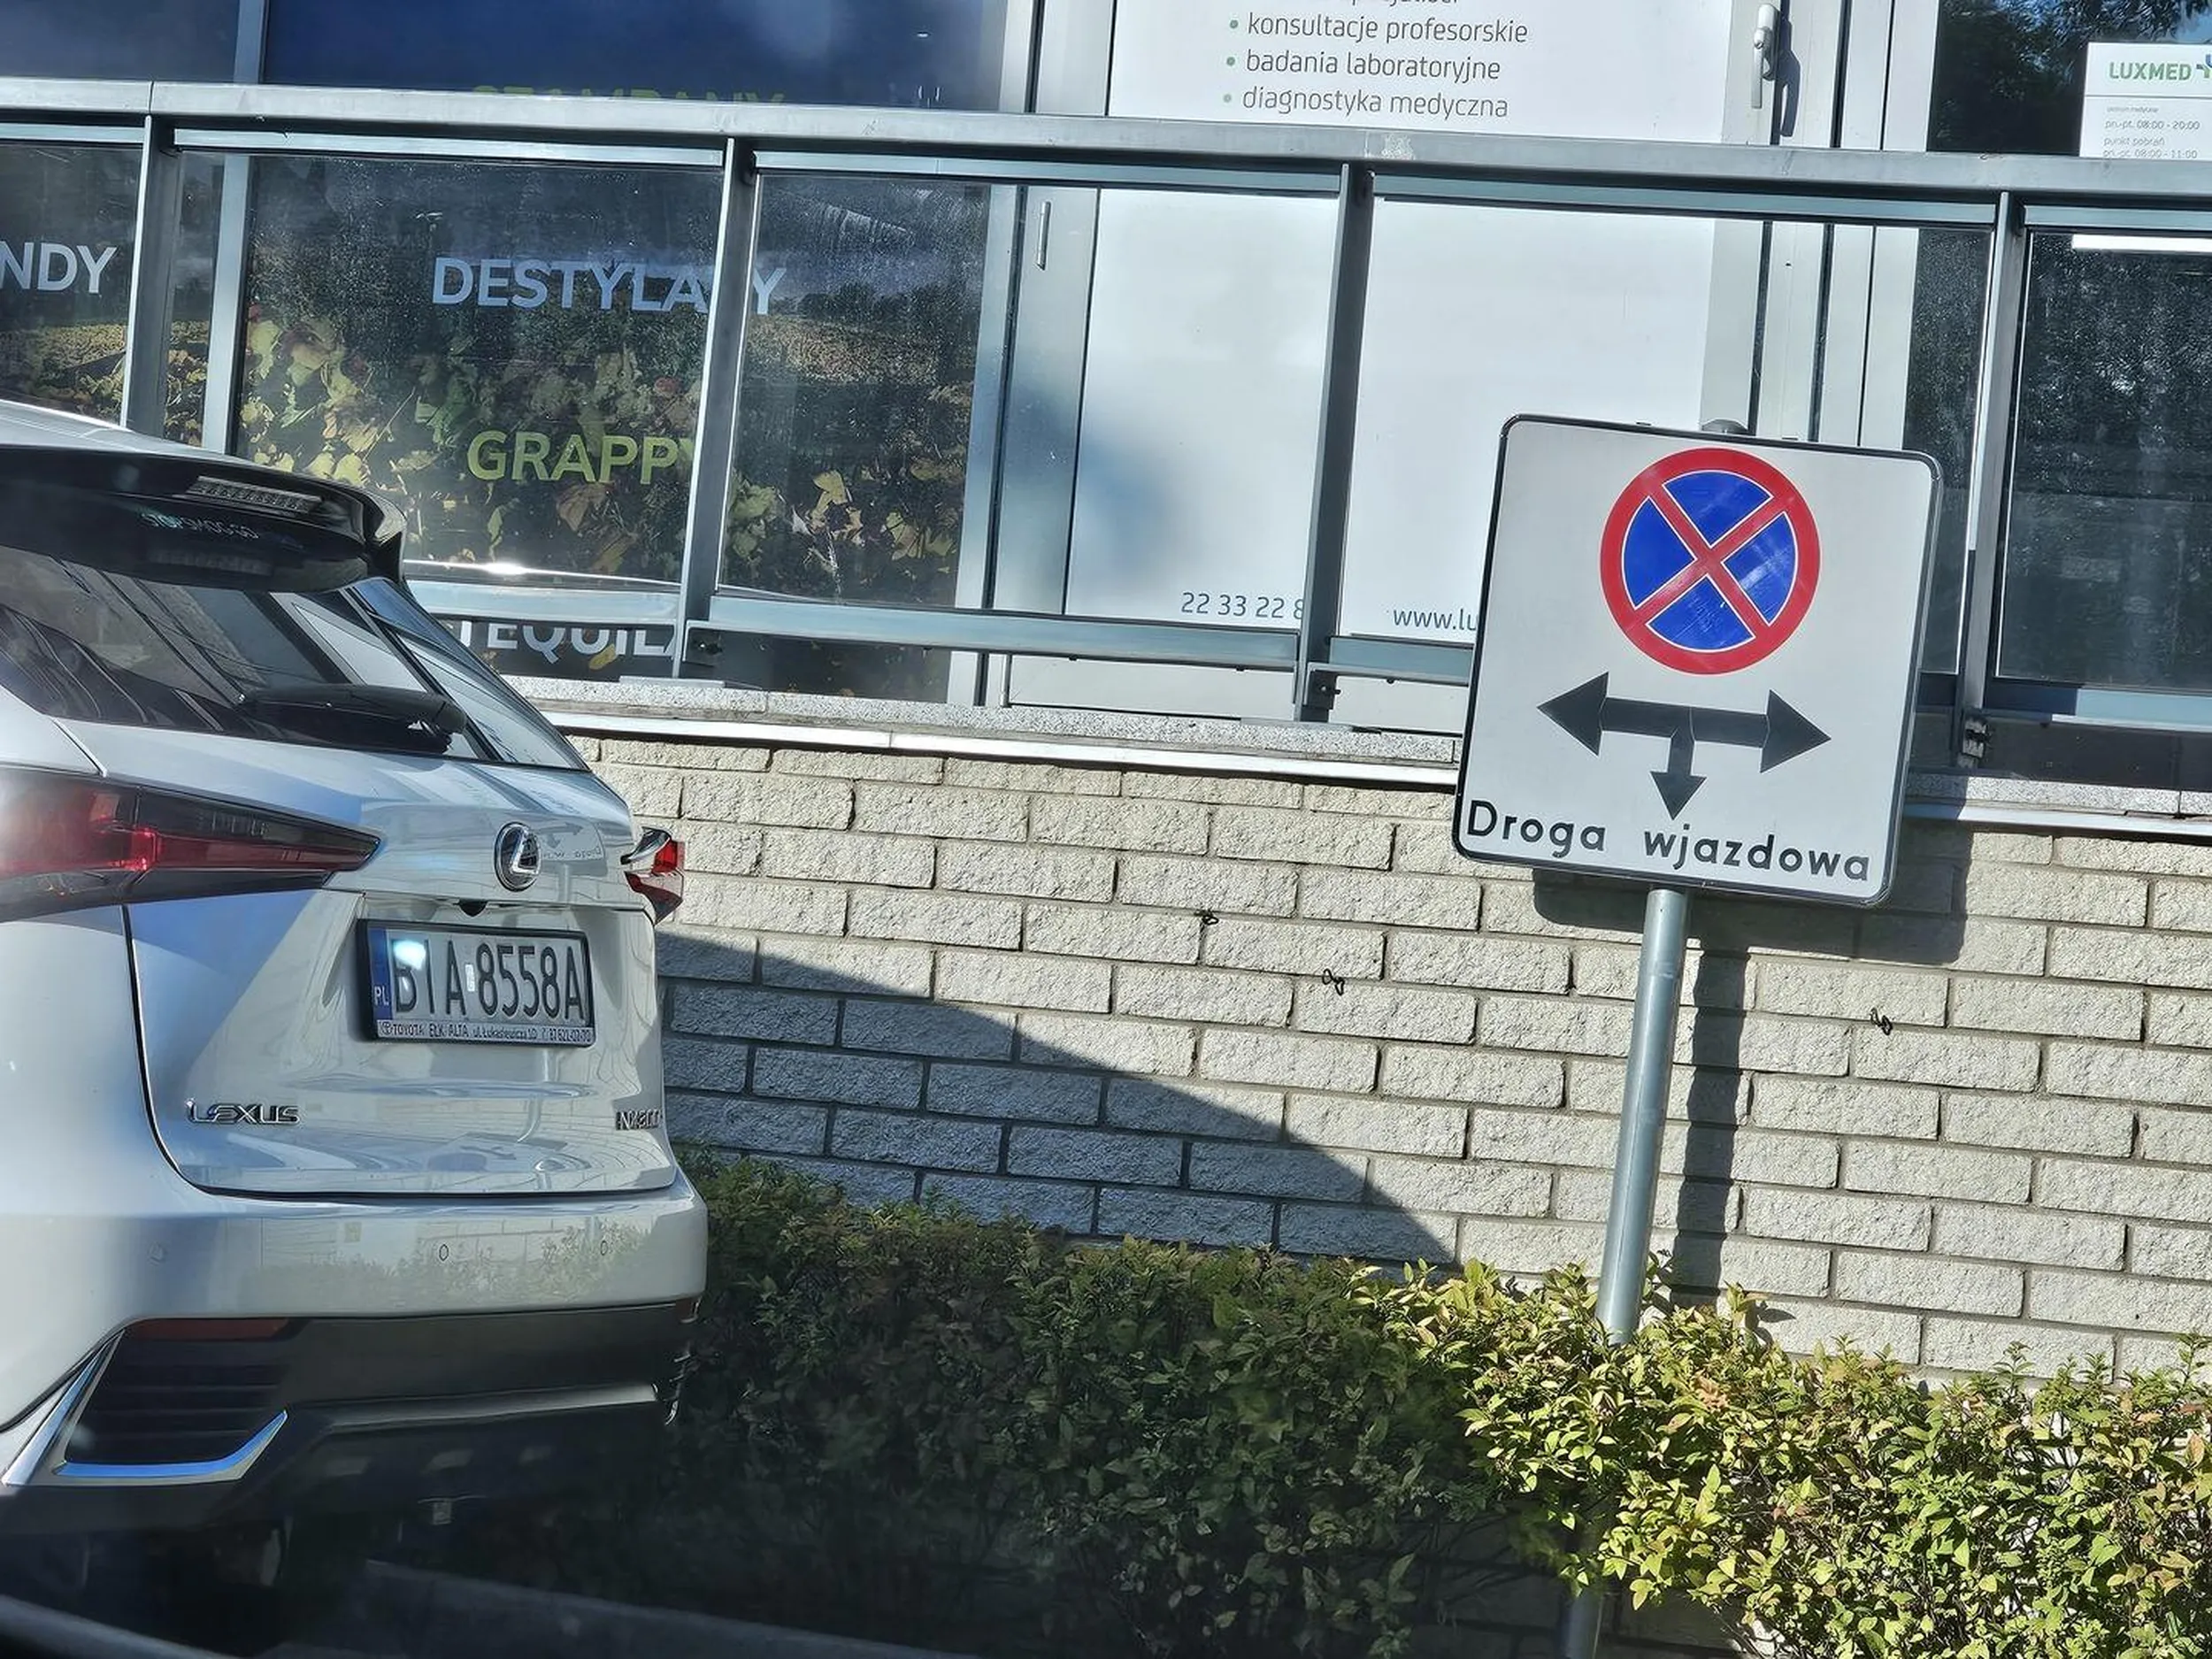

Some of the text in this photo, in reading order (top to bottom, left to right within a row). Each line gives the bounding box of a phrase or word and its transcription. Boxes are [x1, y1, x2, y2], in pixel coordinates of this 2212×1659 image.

[1248, 12, 1528, 43] konsultacje profesorskie
[1246, 50, 1501, 83] badania laboratoryjne
[2108, 62, 2193, 81] LUXMED
[1242, 87, 1509, 120] diagnostyka medyczna
[1180, 591, 1210, 614] 22
[1217, 594, 1248, 618] 33
[1256, 596, 1286, 619] 22
[1466, 799, 1870, 882] Droga wjazdowa
[374, 985, 390, 1006] PL
[475, 942, 585, 1020] 8558A
[186, 1100, 301, 1125] LEXUS
